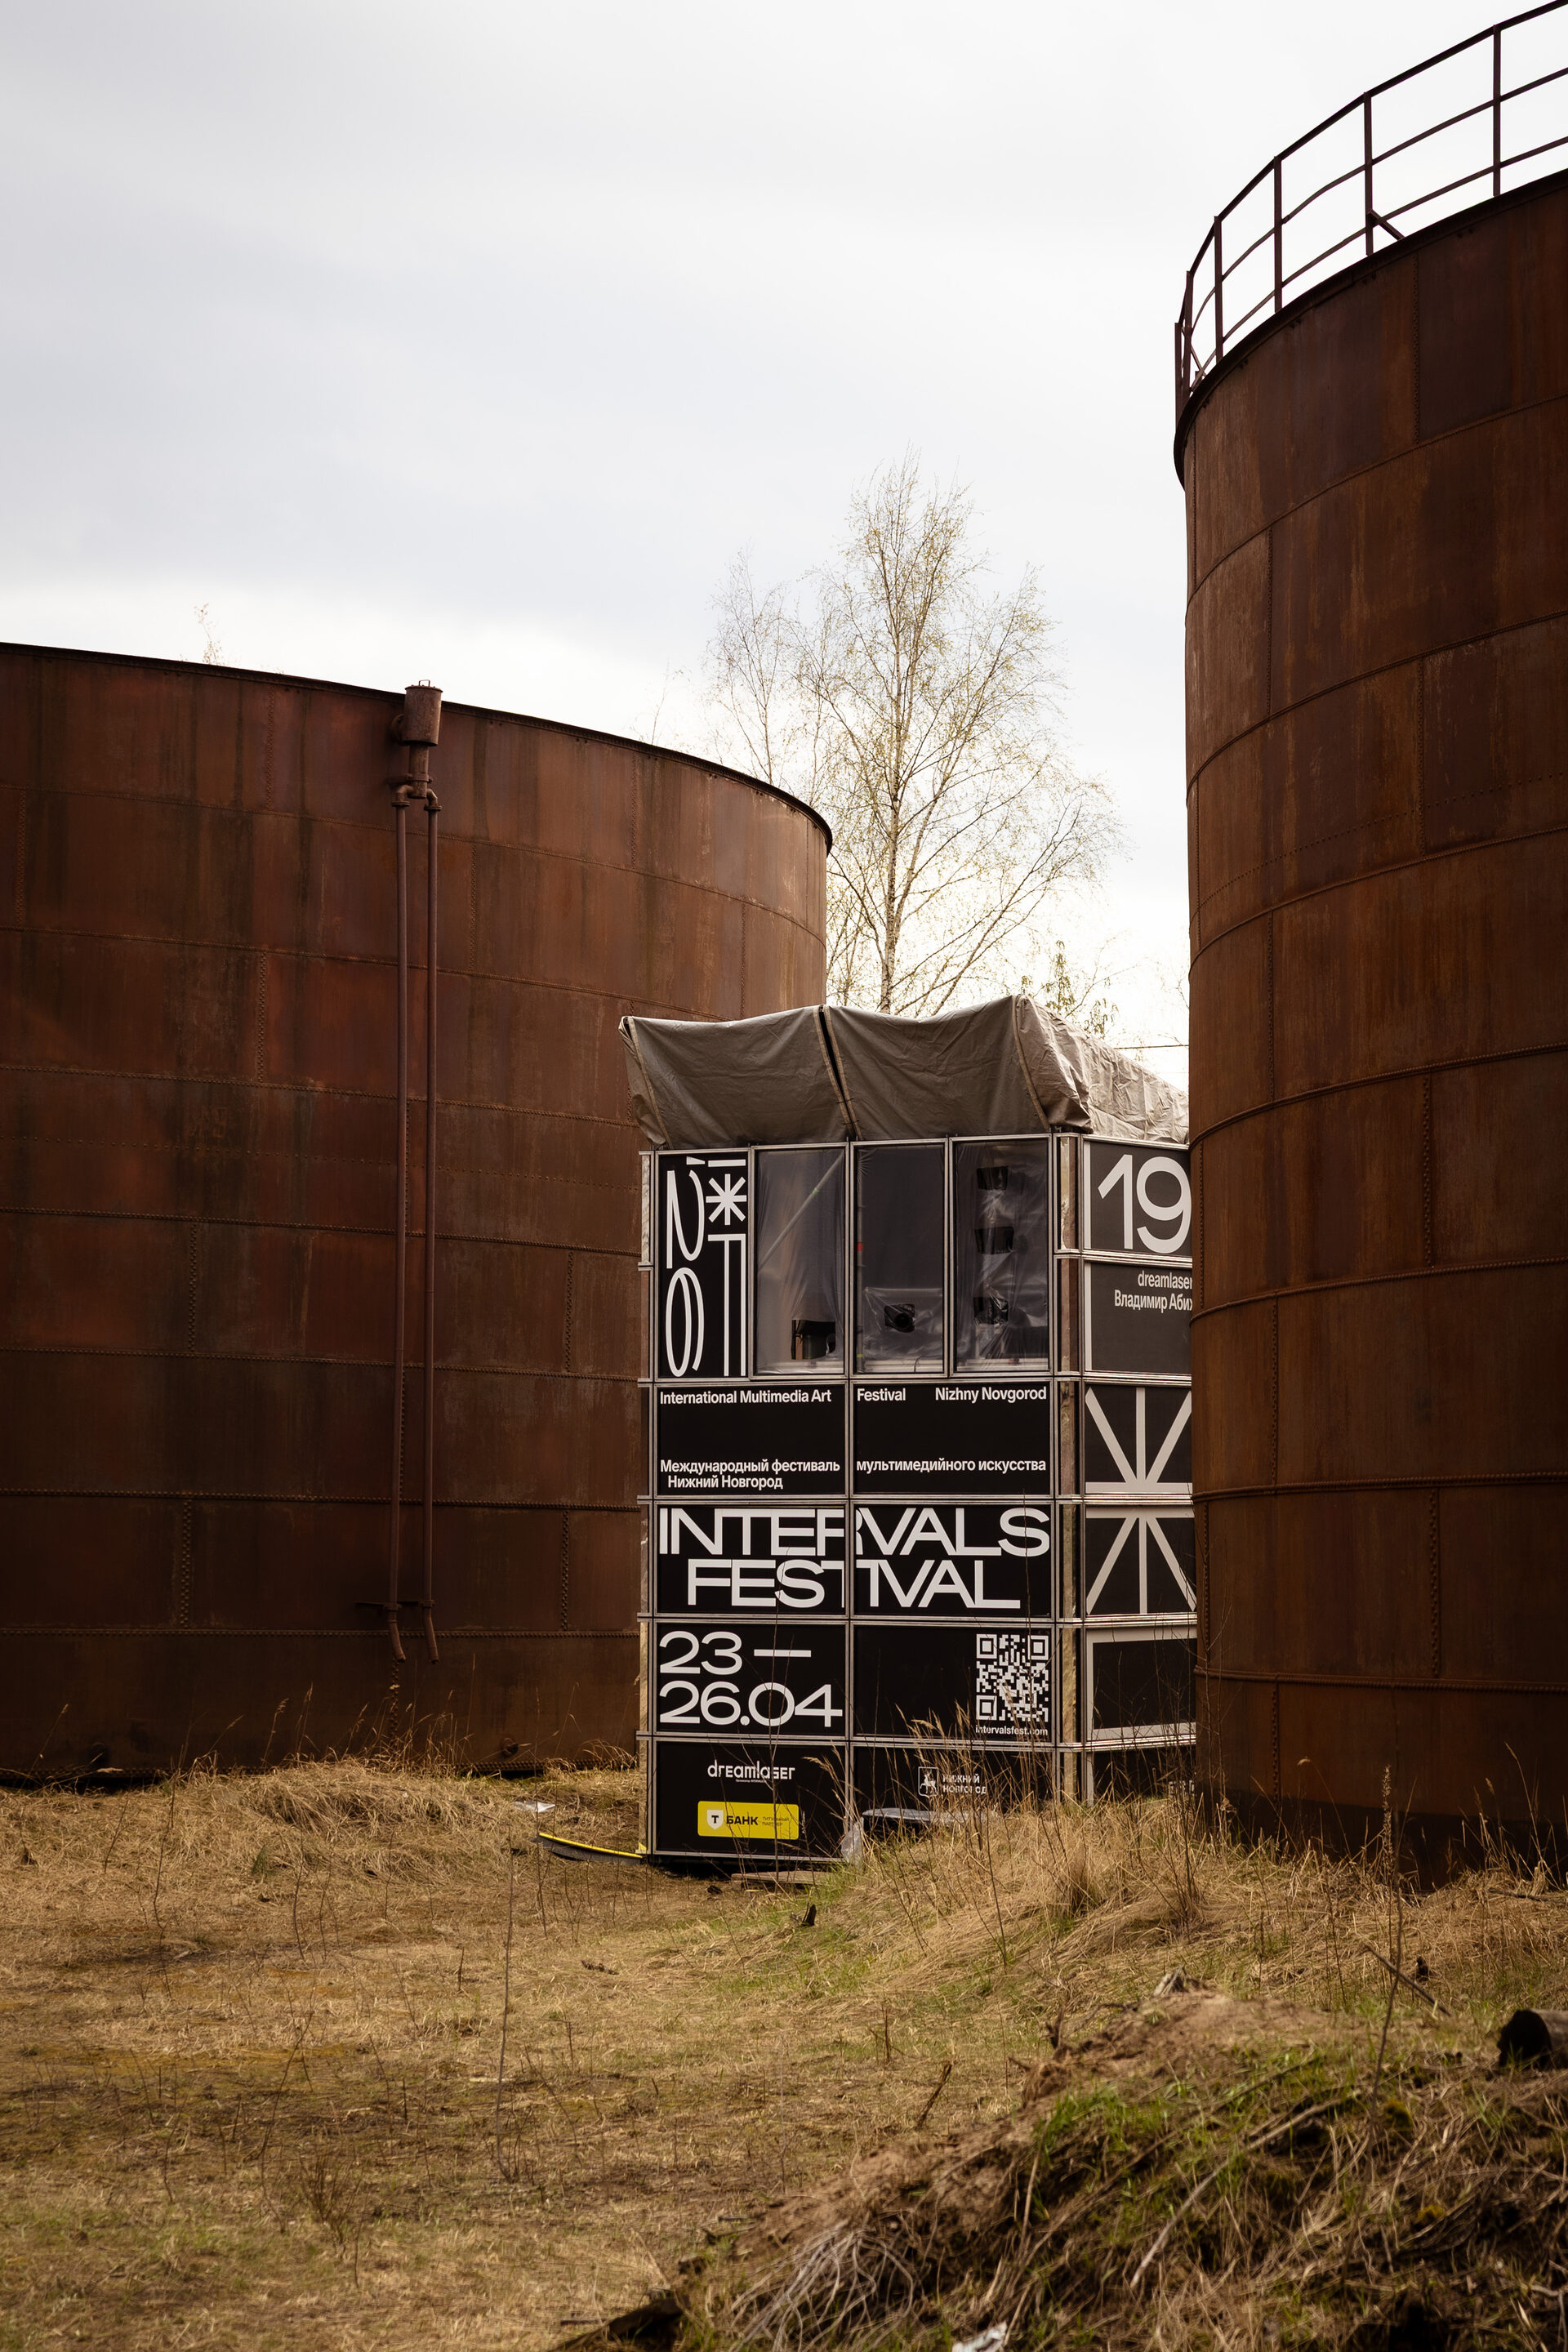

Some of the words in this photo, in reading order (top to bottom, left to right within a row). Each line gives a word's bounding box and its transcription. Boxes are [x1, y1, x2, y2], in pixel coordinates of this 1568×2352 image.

[1098, 1154, 1192, 1254] 19
[1114, 1290, 1168, 1313] Владимир
[660, 1390, 737, 1405] International
[740, 1390, 809, 1403] Multimedia
[811, 1389, 831, 1402] Art
[857, 1388, 906, 1401] Festival
[935, 1387, 979, 1403] Nizhny
[982, 1386, 1047, 1403] Novgorod
[661, 1459, 768, 1475] Международный
[771, 1459, 840, 1475] фестиваль
[857, 1458, 976, 1474] мультимедийного
[978, 1459, 1046, 1474] искусства
[668, 1475, 719, 1488] Нижний
[721, 1475, 783, 1490] Новгород
[660, 1508, 1050, 1557] INTERVALS
[659, 1631, 742, 1675] 23
[659, 1681, 843, 1728] 26.04
[975, 1725, 1049, 1736] intervalsfest.com
[707, 1759, 795, 1780] dreamlaser
[726, 1815, 759, 1825] БАНК
